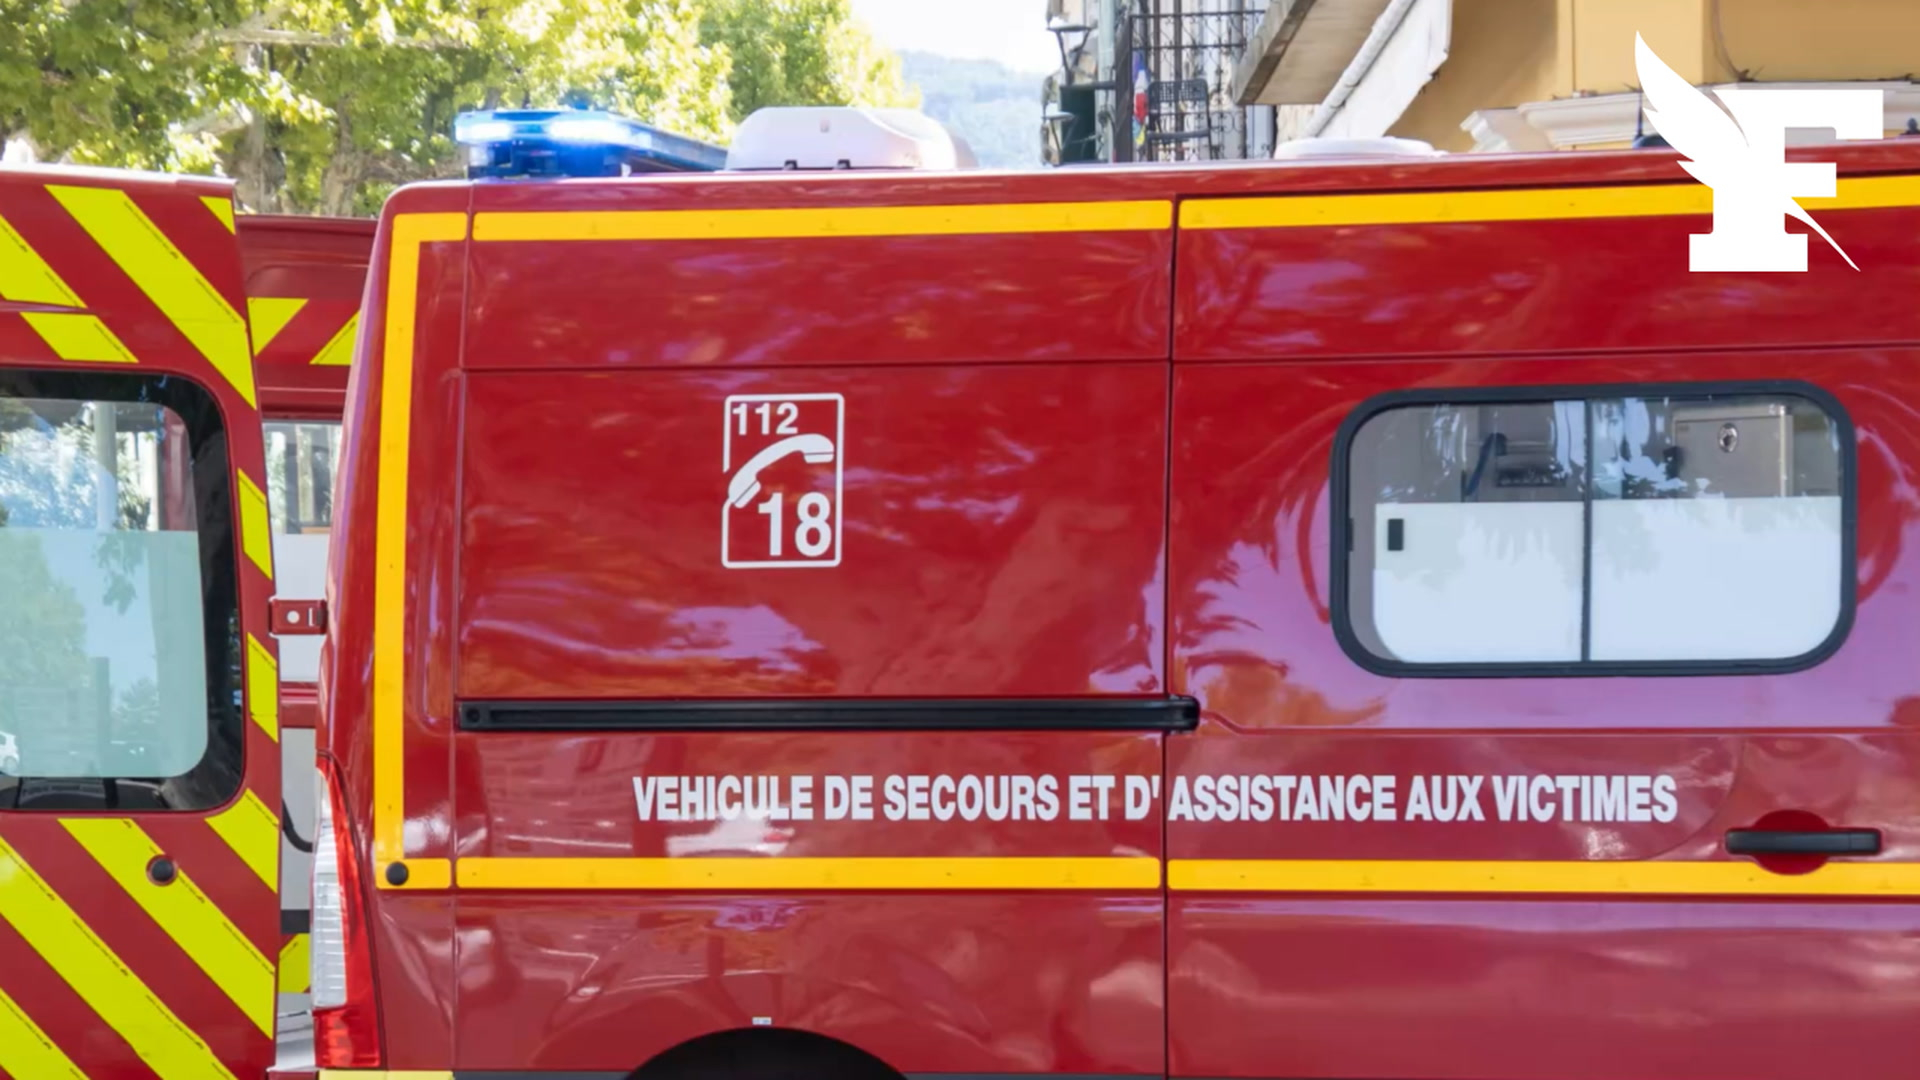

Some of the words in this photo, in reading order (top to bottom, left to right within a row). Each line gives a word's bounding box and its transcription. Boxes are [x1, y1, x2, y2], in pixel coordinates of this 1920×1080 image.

[732, 402, 799, 436] 112
[758, 491, 832, 557] 18
[633, 775, 814, 821] VEHICULE
[824, 775, 874, 821] DE
[884, 774, 1059, 822] SECOURS
[1069, 775, 1116, 821] ET
[1167, 774, 1397, 822] ASSISTANCE
[1405, 775, 1485, 822] AUX
[1492, 774, 1678, 822] VICTIMES
